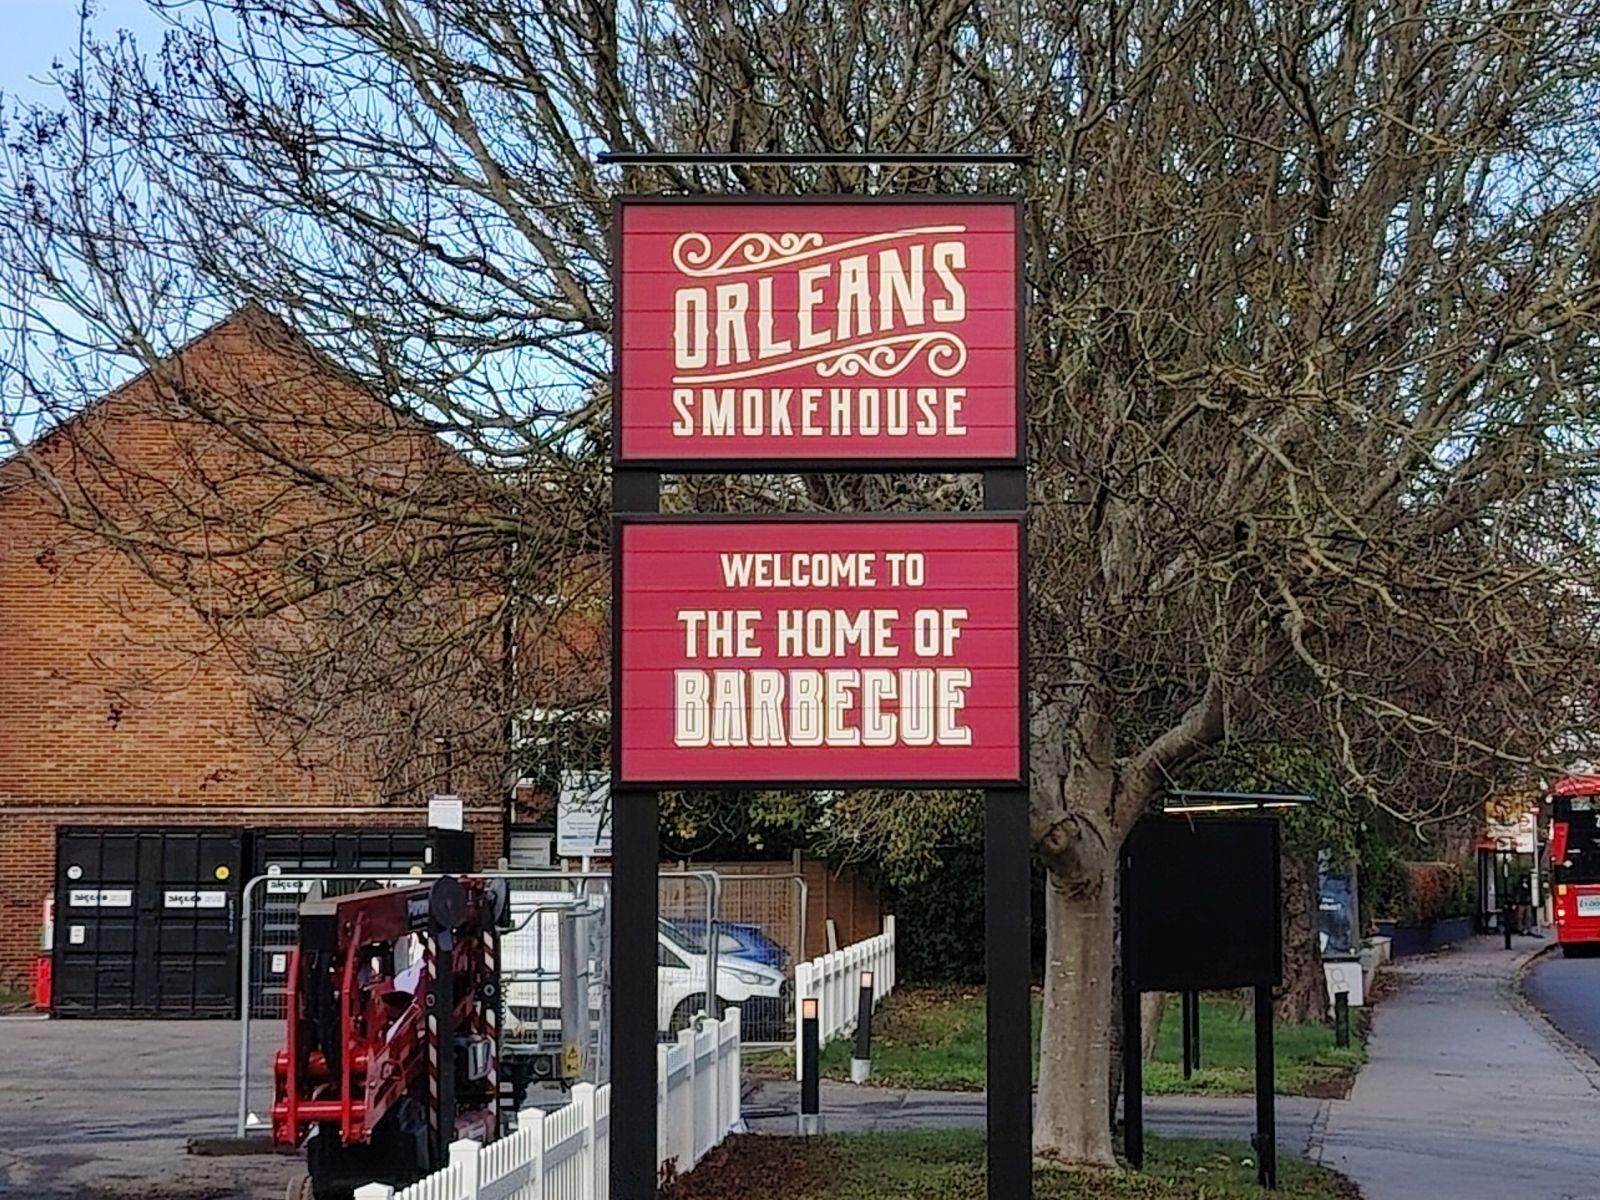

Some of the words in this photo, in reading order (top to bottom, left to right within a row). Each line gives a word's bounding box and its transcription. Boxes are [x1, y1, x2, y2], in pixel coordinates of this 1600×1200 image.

[673, 241, 967, 369] ORLEANS
[672, 388, 967, 436] SMOKEHOUSE
[720, 553, 876, 587] WELCOME
[885, 553, 924, 587] TO
[677, 610, 762, 658] THE
[777, 609, 899, 657] HOME
[914, 609, 968, 657] OF
[674, 668, 972, 747] BARBECUE
